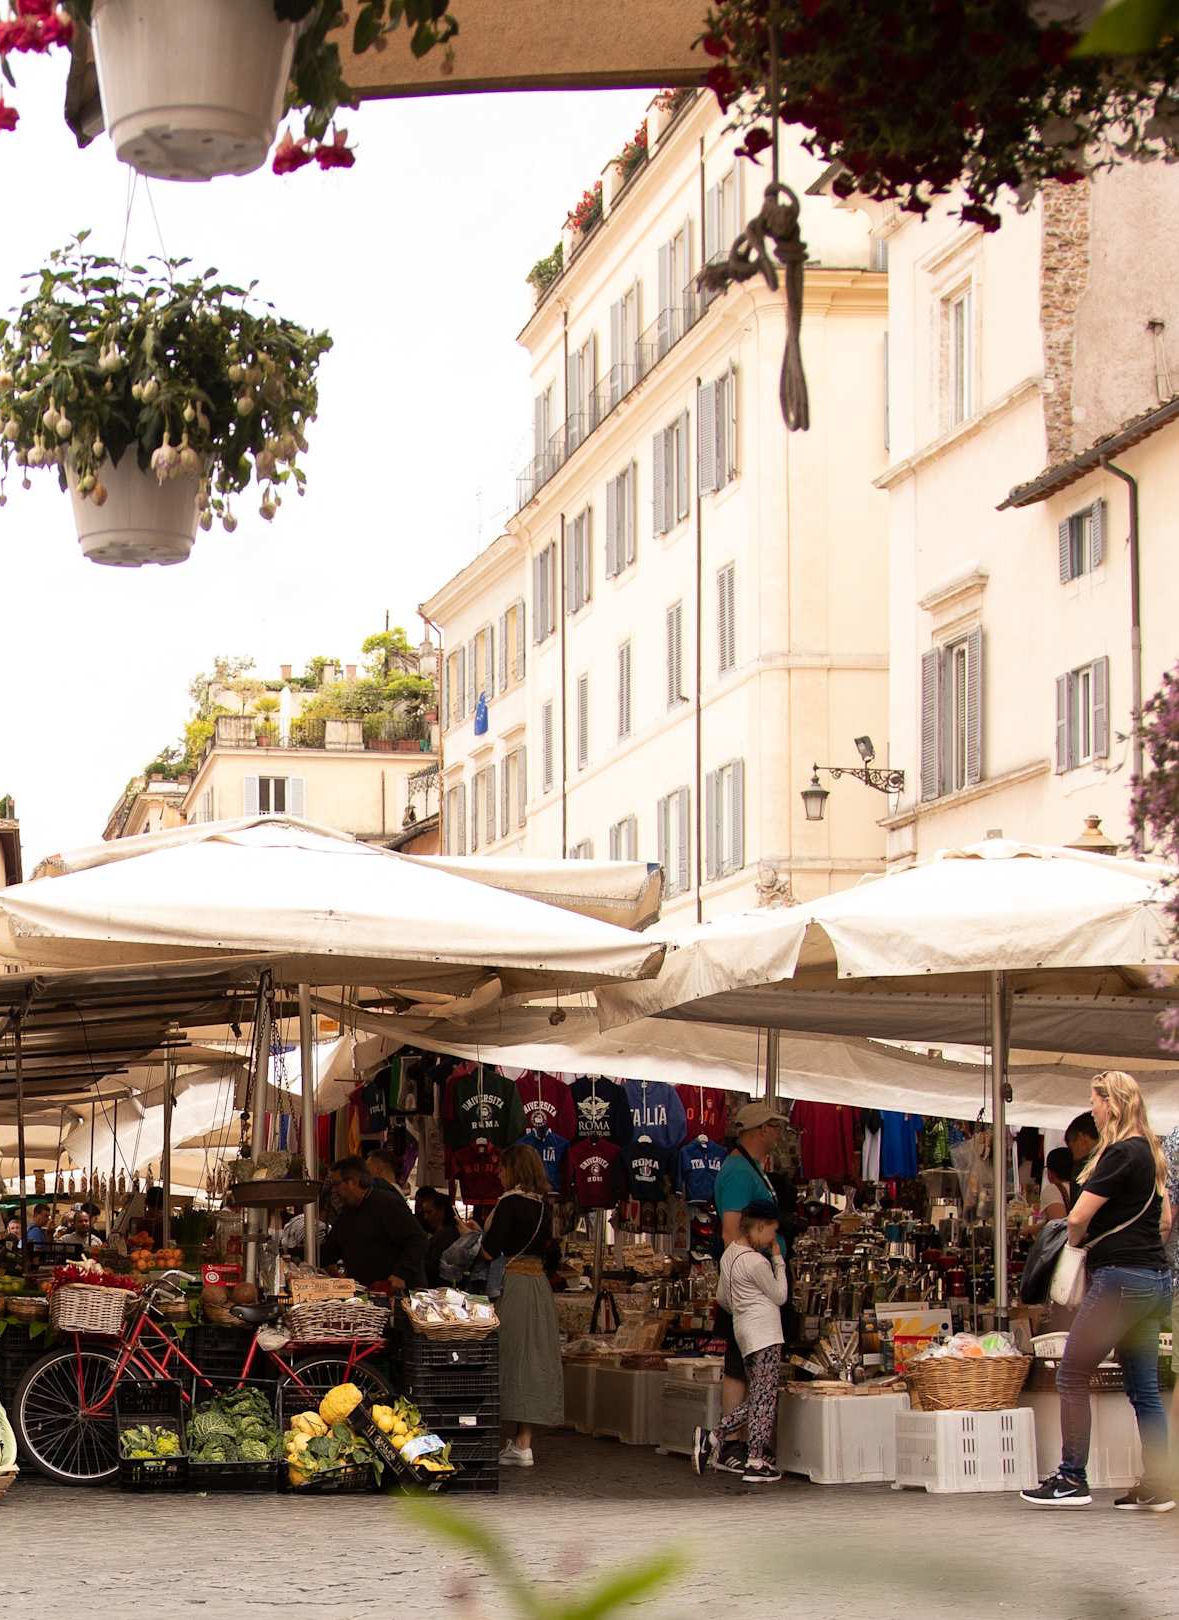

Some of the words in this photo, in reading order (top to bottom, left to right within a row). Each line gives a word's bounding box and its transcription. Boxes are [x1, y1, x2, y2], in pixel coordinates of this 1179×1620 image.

[578, 1120, 610, 1131] ROMA
[631, 1158, 659, 1170] ROMA
[690, 1158, 721, 1171] ITALIA
